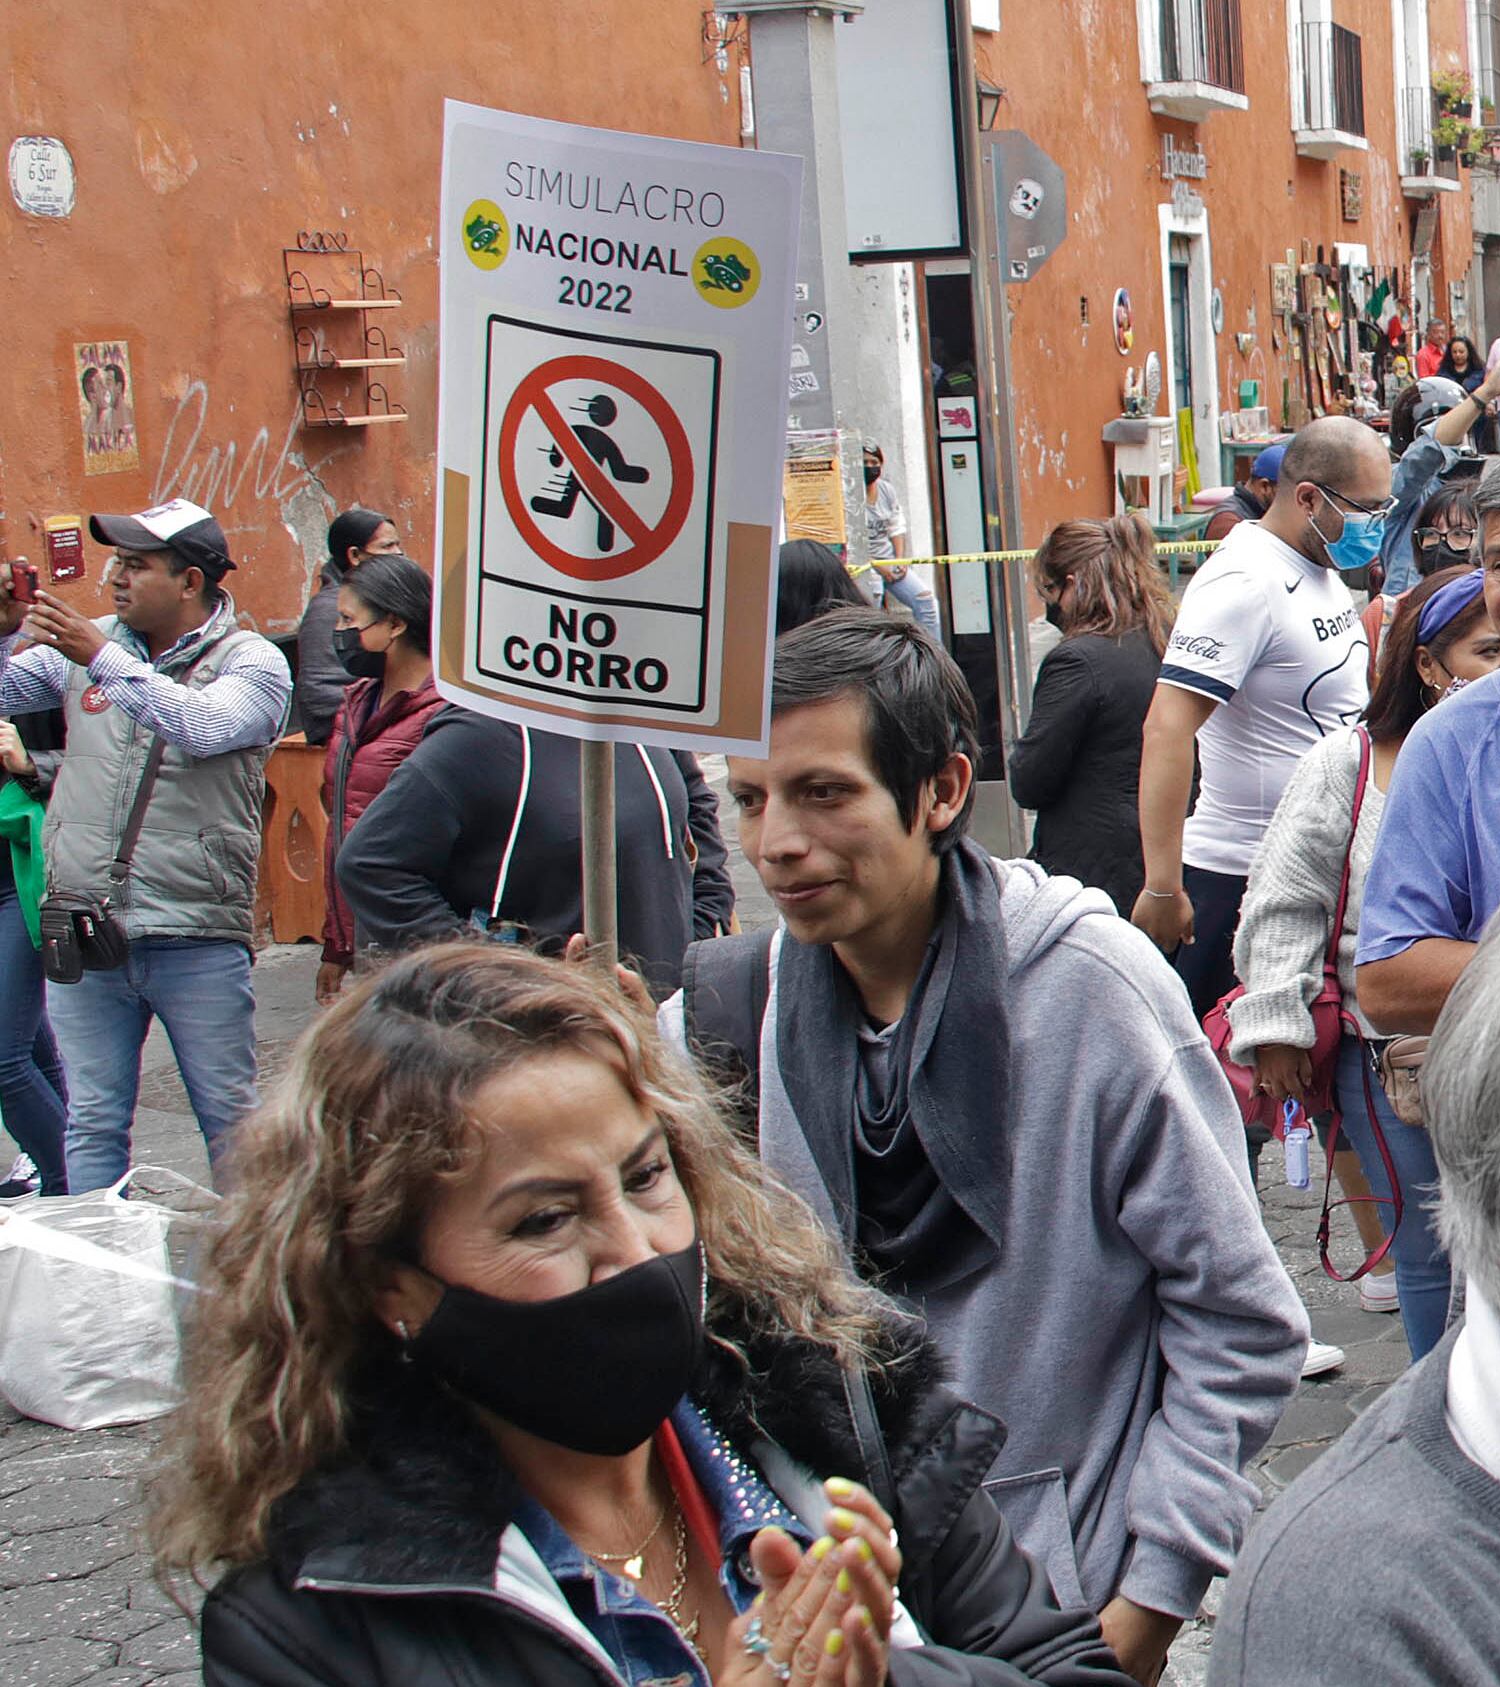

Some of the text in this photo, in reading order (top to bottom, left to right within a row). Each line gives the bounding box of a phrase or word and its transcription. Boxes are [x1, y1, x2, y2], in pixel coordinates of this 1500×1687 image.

[29, 163, 57, 181] 6 Sur
[31, 148, 51, 161] Calle
[505, 161, 725, 227] SIMULACRO
[516, 223, 689, 277] NACIONAL
[558, 276, 633, 314] 2022
[550, 604, 616, 648] NO
[504, 635, 668, 693] CORRO
